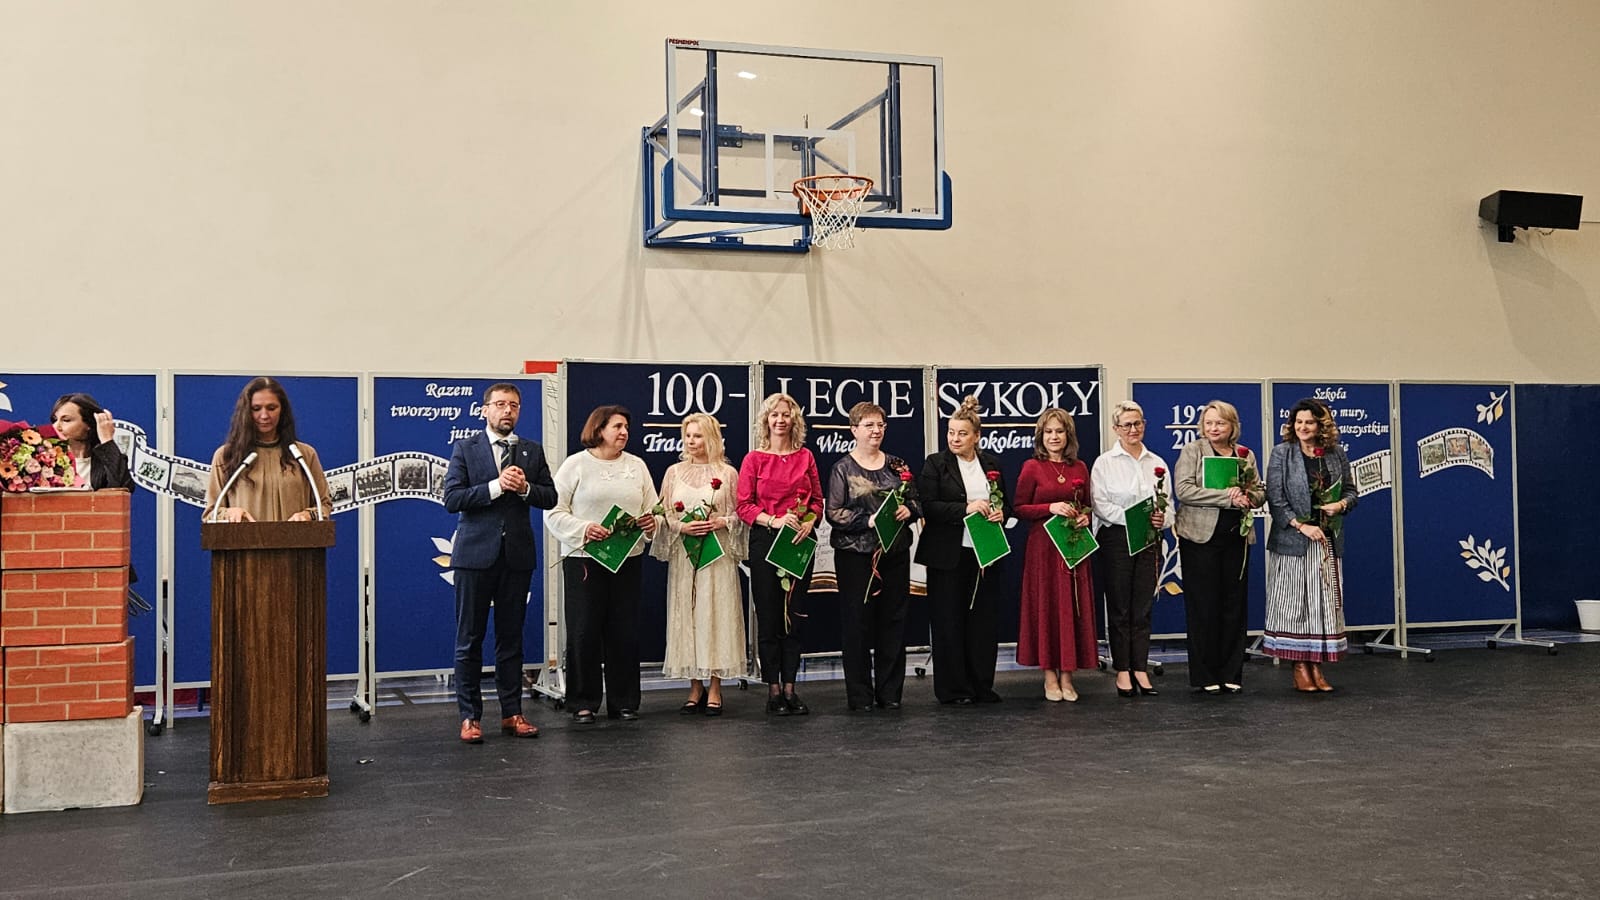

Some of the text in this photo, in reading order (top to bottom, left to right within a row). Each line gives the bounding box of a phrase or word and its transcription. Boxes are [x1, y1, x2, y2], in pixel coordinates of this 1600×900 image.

[425, 383, 473, 398] Razem
[1313, 387, 1347, 402] Szkoła
[938, 381, 1099, 418] SZKOŁY
[390, 405, 461, 420] tworzymy
[1340, 408, 1368, 421] mury,
[448, 425, 483, 444] jutr
[1338, 421, 1389, 437] wszystkim
